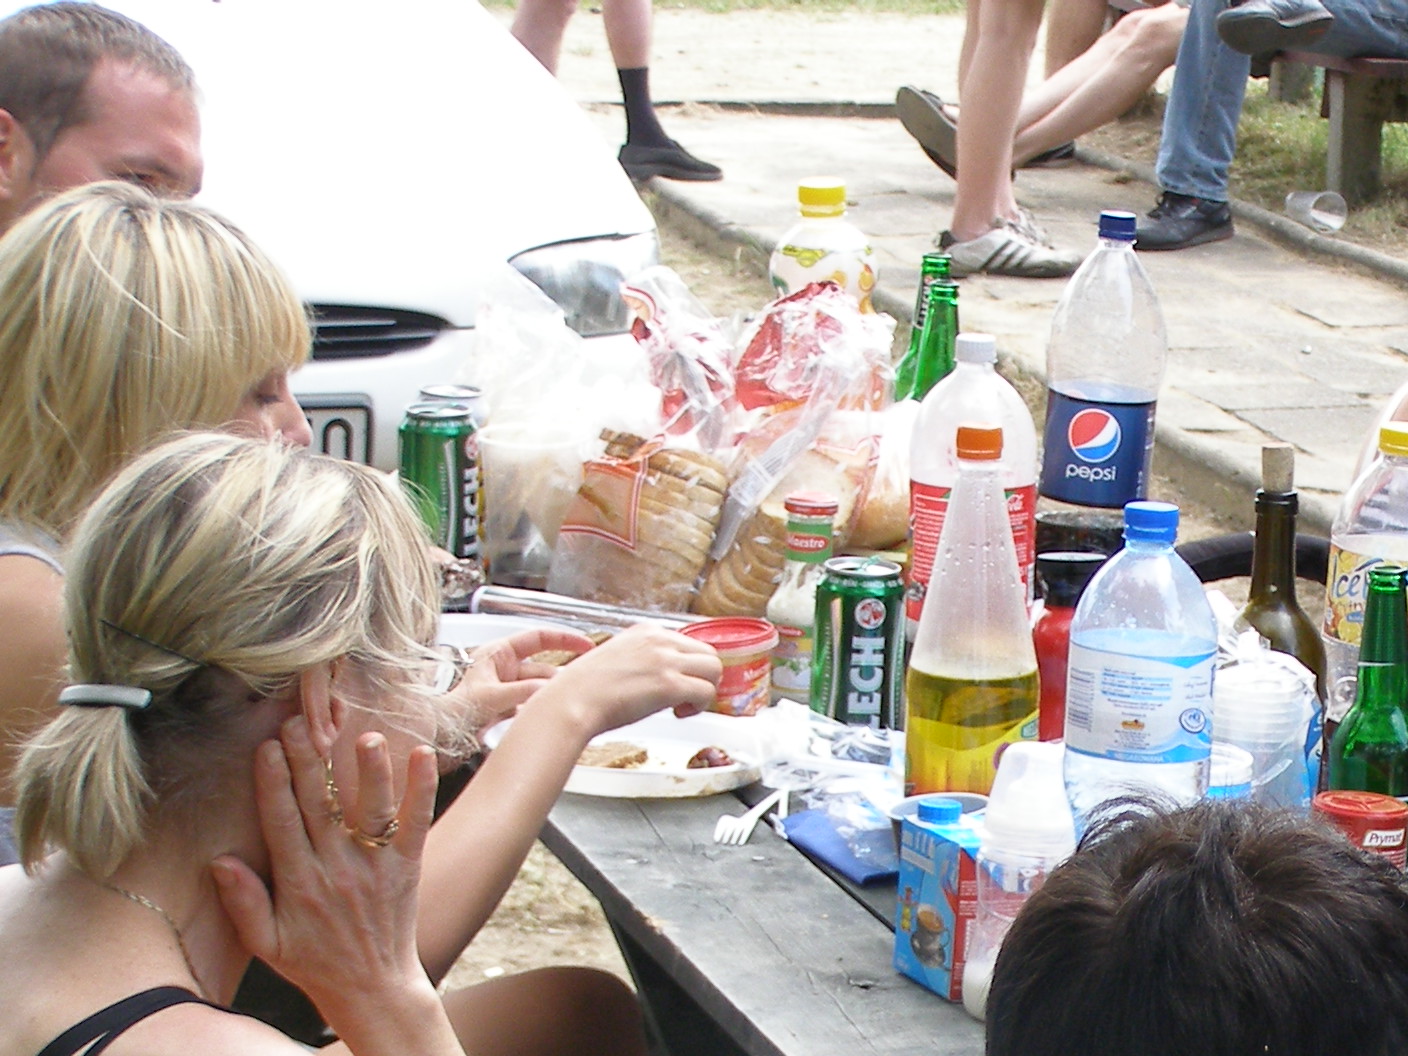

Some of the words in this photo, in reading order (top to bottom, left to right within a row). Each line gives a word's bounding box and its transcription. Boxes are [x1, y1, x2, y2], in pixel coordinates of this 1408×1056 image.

[1065, 463, 1117, 482] pepsi
[463, 467, 480, 557] LECH
[847, 636, 886, 729] LECH
[1368, 831, 1403, 845] Prymat
